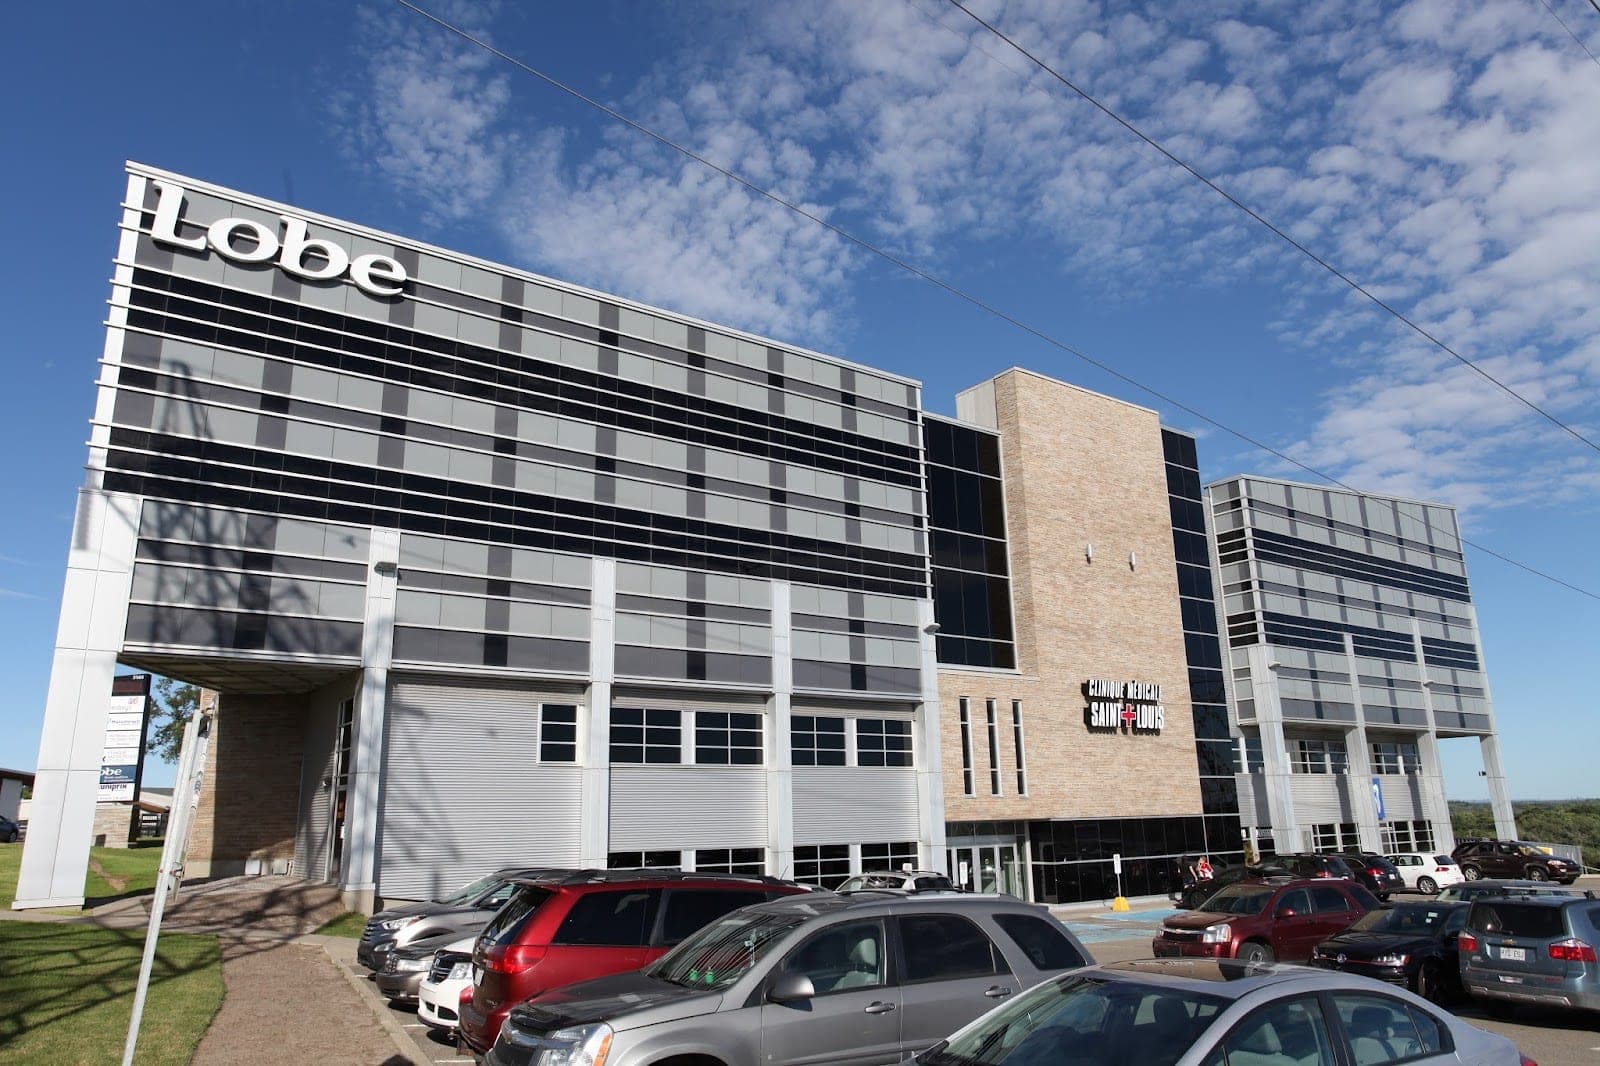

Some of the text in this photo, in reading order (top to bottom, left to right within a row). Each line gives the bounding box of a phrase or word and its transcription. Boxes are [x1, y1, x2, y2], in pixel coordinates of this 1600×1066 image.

[151, 179, 407, 296] Lobe
[1088, 680, 1125, 699] CLINIQUE
[1091, 702, 1165, 729] SAINT LOUIS
[100, 767, 122, 776] obe
